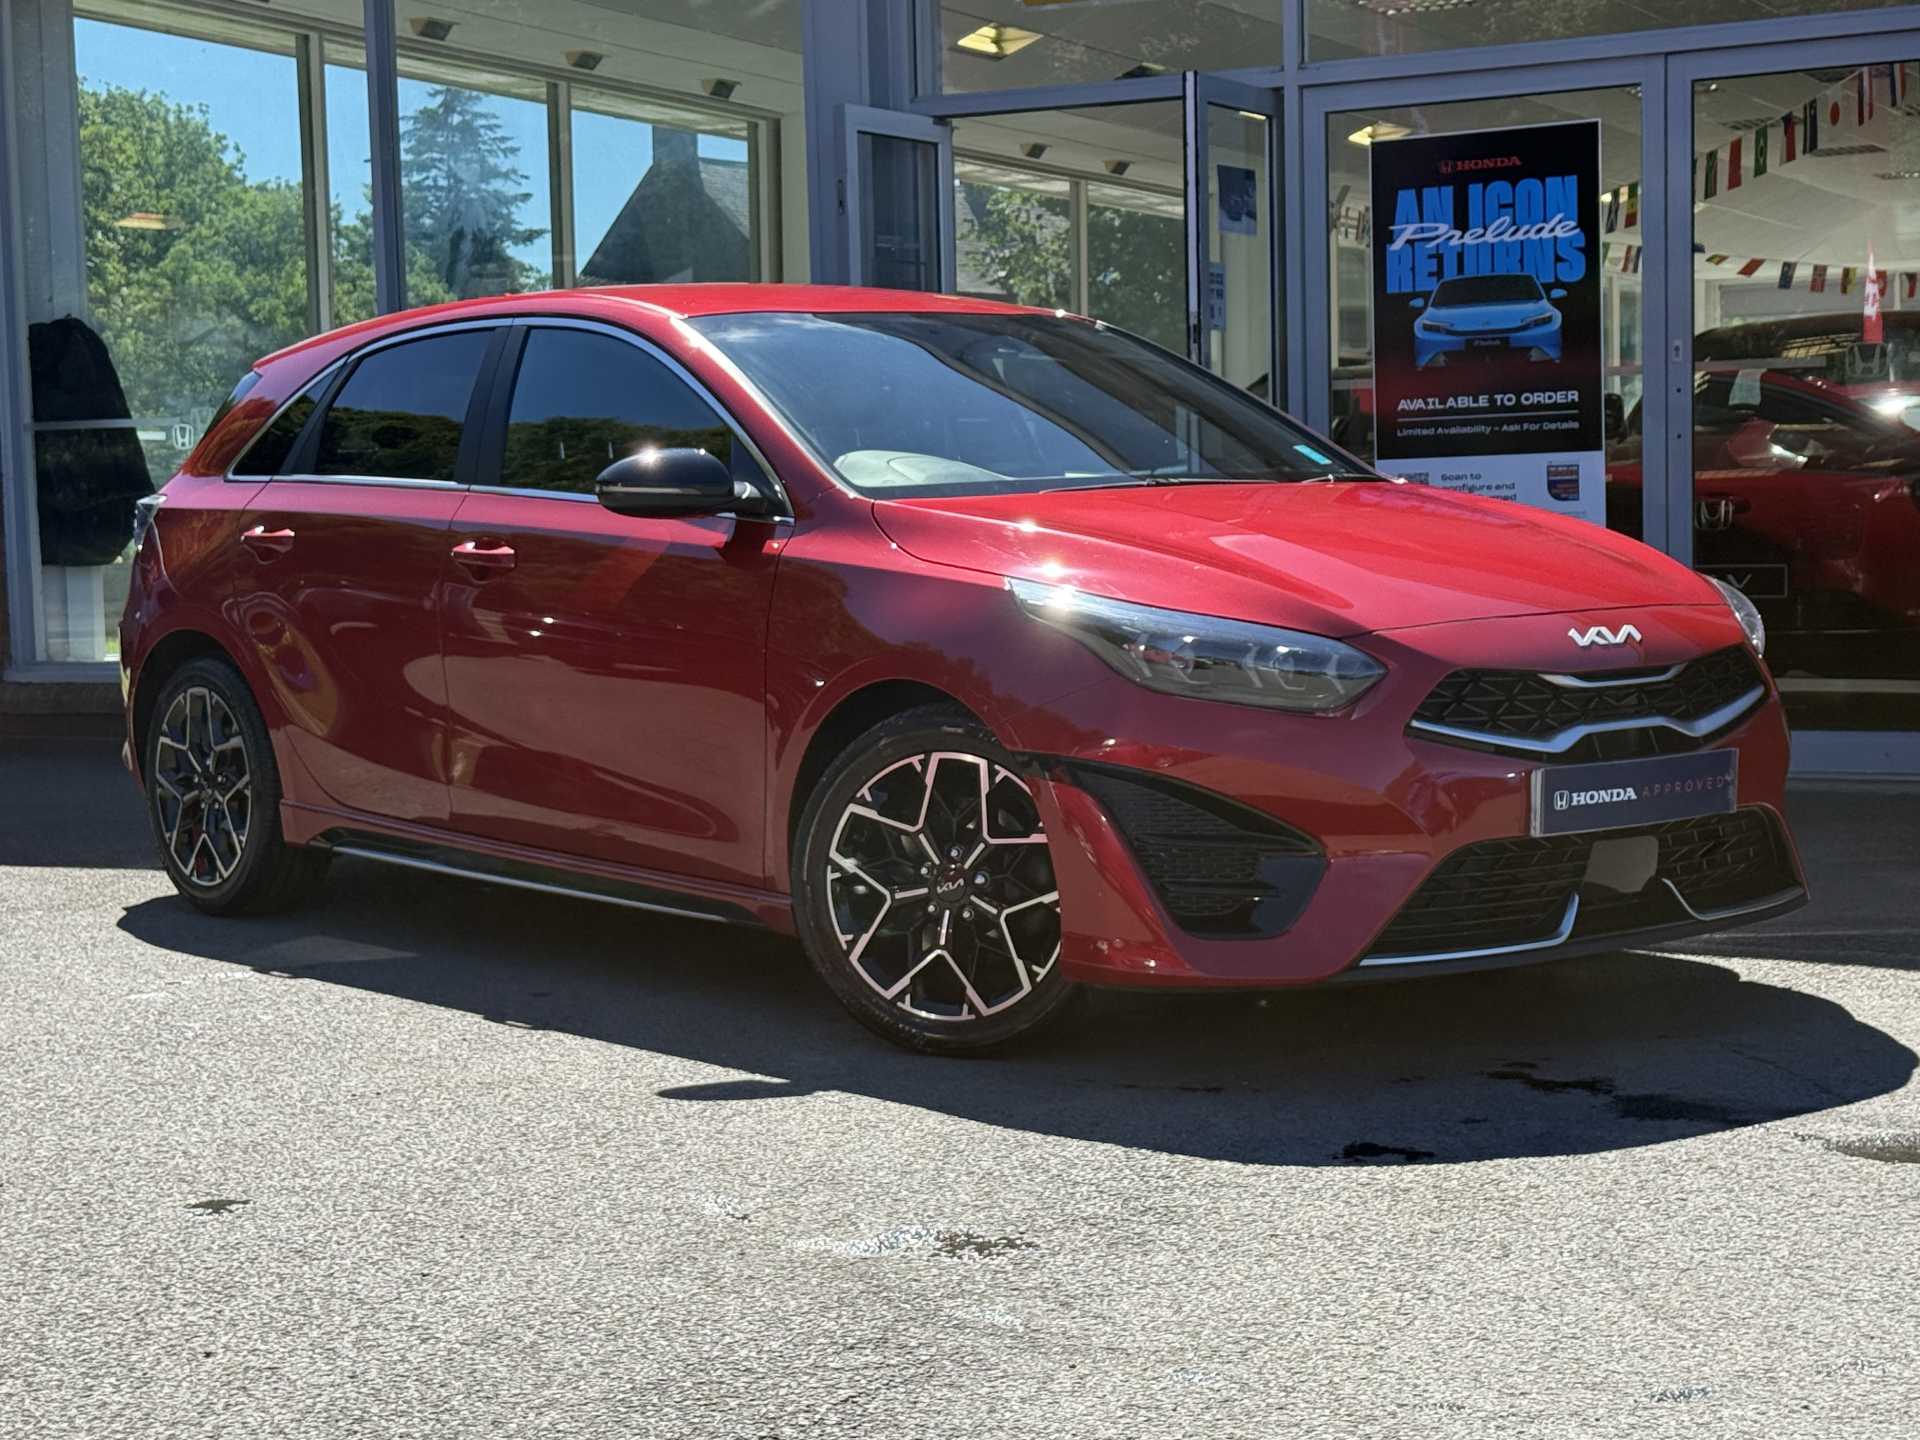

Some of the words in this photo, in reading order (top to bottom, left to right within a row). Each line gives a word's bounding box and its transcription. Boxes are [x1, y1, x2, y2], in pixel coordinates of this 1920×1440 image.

[1456, 156, 1521, 171] HONDA
[1393, 185, 1454, 241] AN
[1468, 174, 1578, 236] ICON
[1388, 212, 1581, 250] Prelude
[1386, 230, 1586, 294] RETURNS
[1397, 394, 1489, 411] AVAILABLE
[1494, 393, 1516, 407] TO
[1520, 390, 1579, 405] ORDER
[1396, 426, 1436, 437] Limited
[1437, 424, 1492, 435] Availability
[1502, 423, 1521, 432] Ask
[1523, 422, 1540, 431] For
[1543, 420, 1580, 430] Details
[1441, 473, 1468, 481] Scan
[1494, 482, 1516, 490] and
[1568, 624, 1642, 646] KIA
[1571, 787, 1637, 806] HONDA
[1642, 776, 1724, 800] APPROVED
